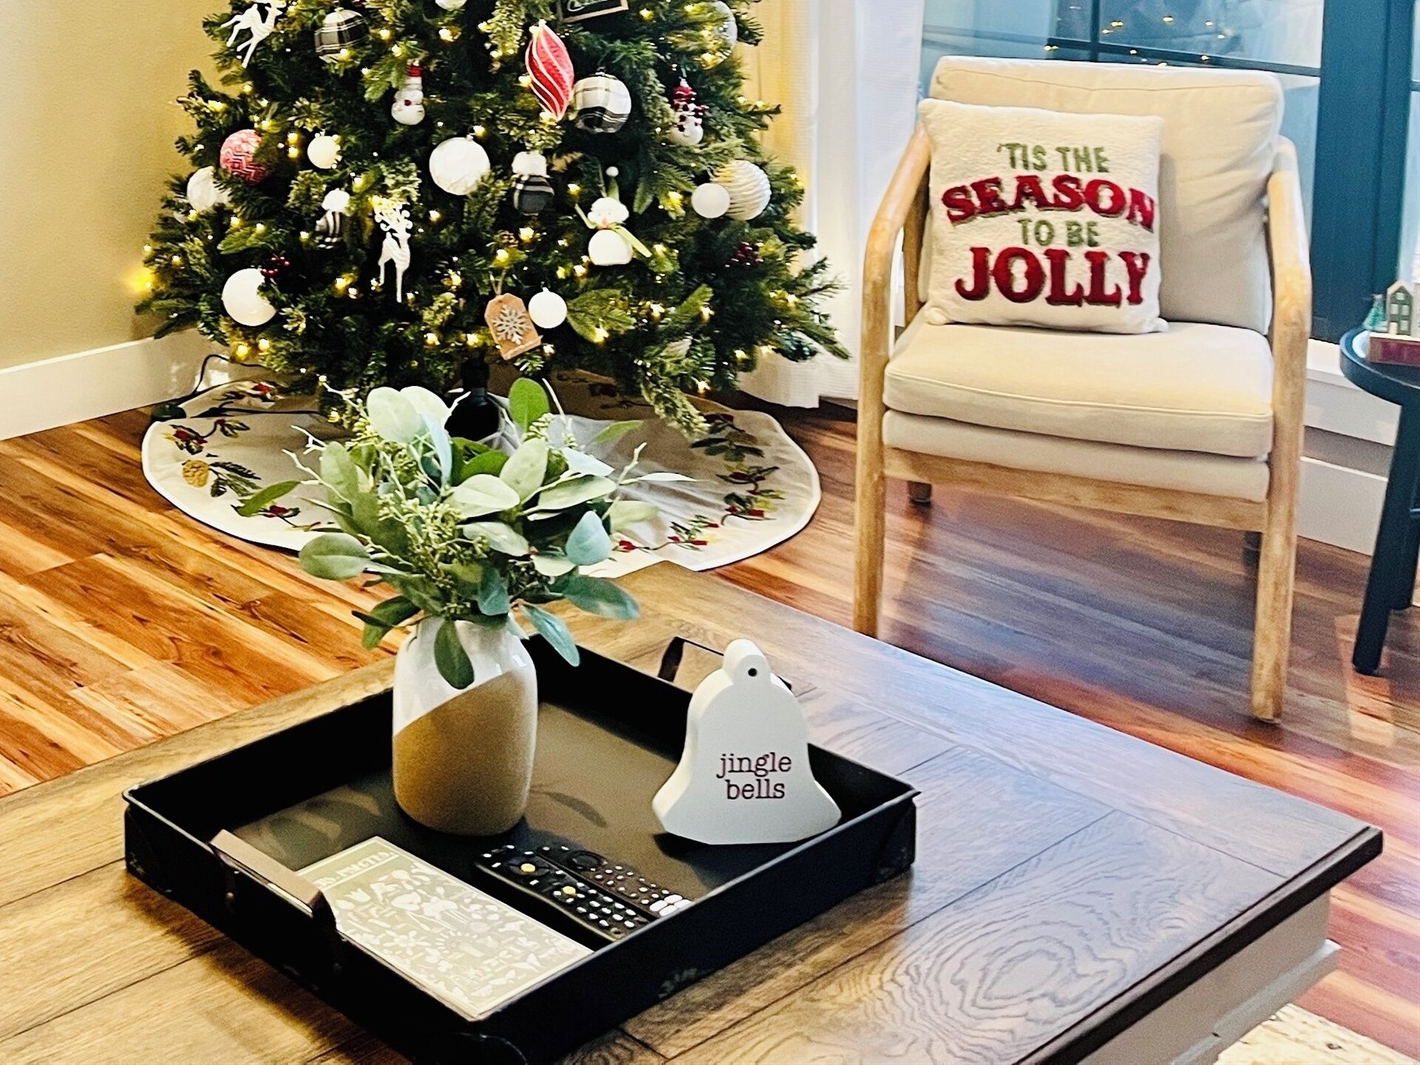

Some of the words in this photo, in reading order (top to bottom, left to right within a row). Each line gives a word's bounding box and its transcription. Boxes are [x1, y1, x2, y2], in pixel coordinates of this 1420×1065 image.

[996, 142, 1048, 171] 'TIS
[1055, 146, 1110, 173] THE
[941, 174, 1155, 233] SEASON
[1017, 219, 1055, 246] TO
[1066, 220, 1101, 247] BE
[954, 246, 1151, 308] JOLLY
[716, 751, 792, 779] jingle
[725, 779, 786, 800] bells
